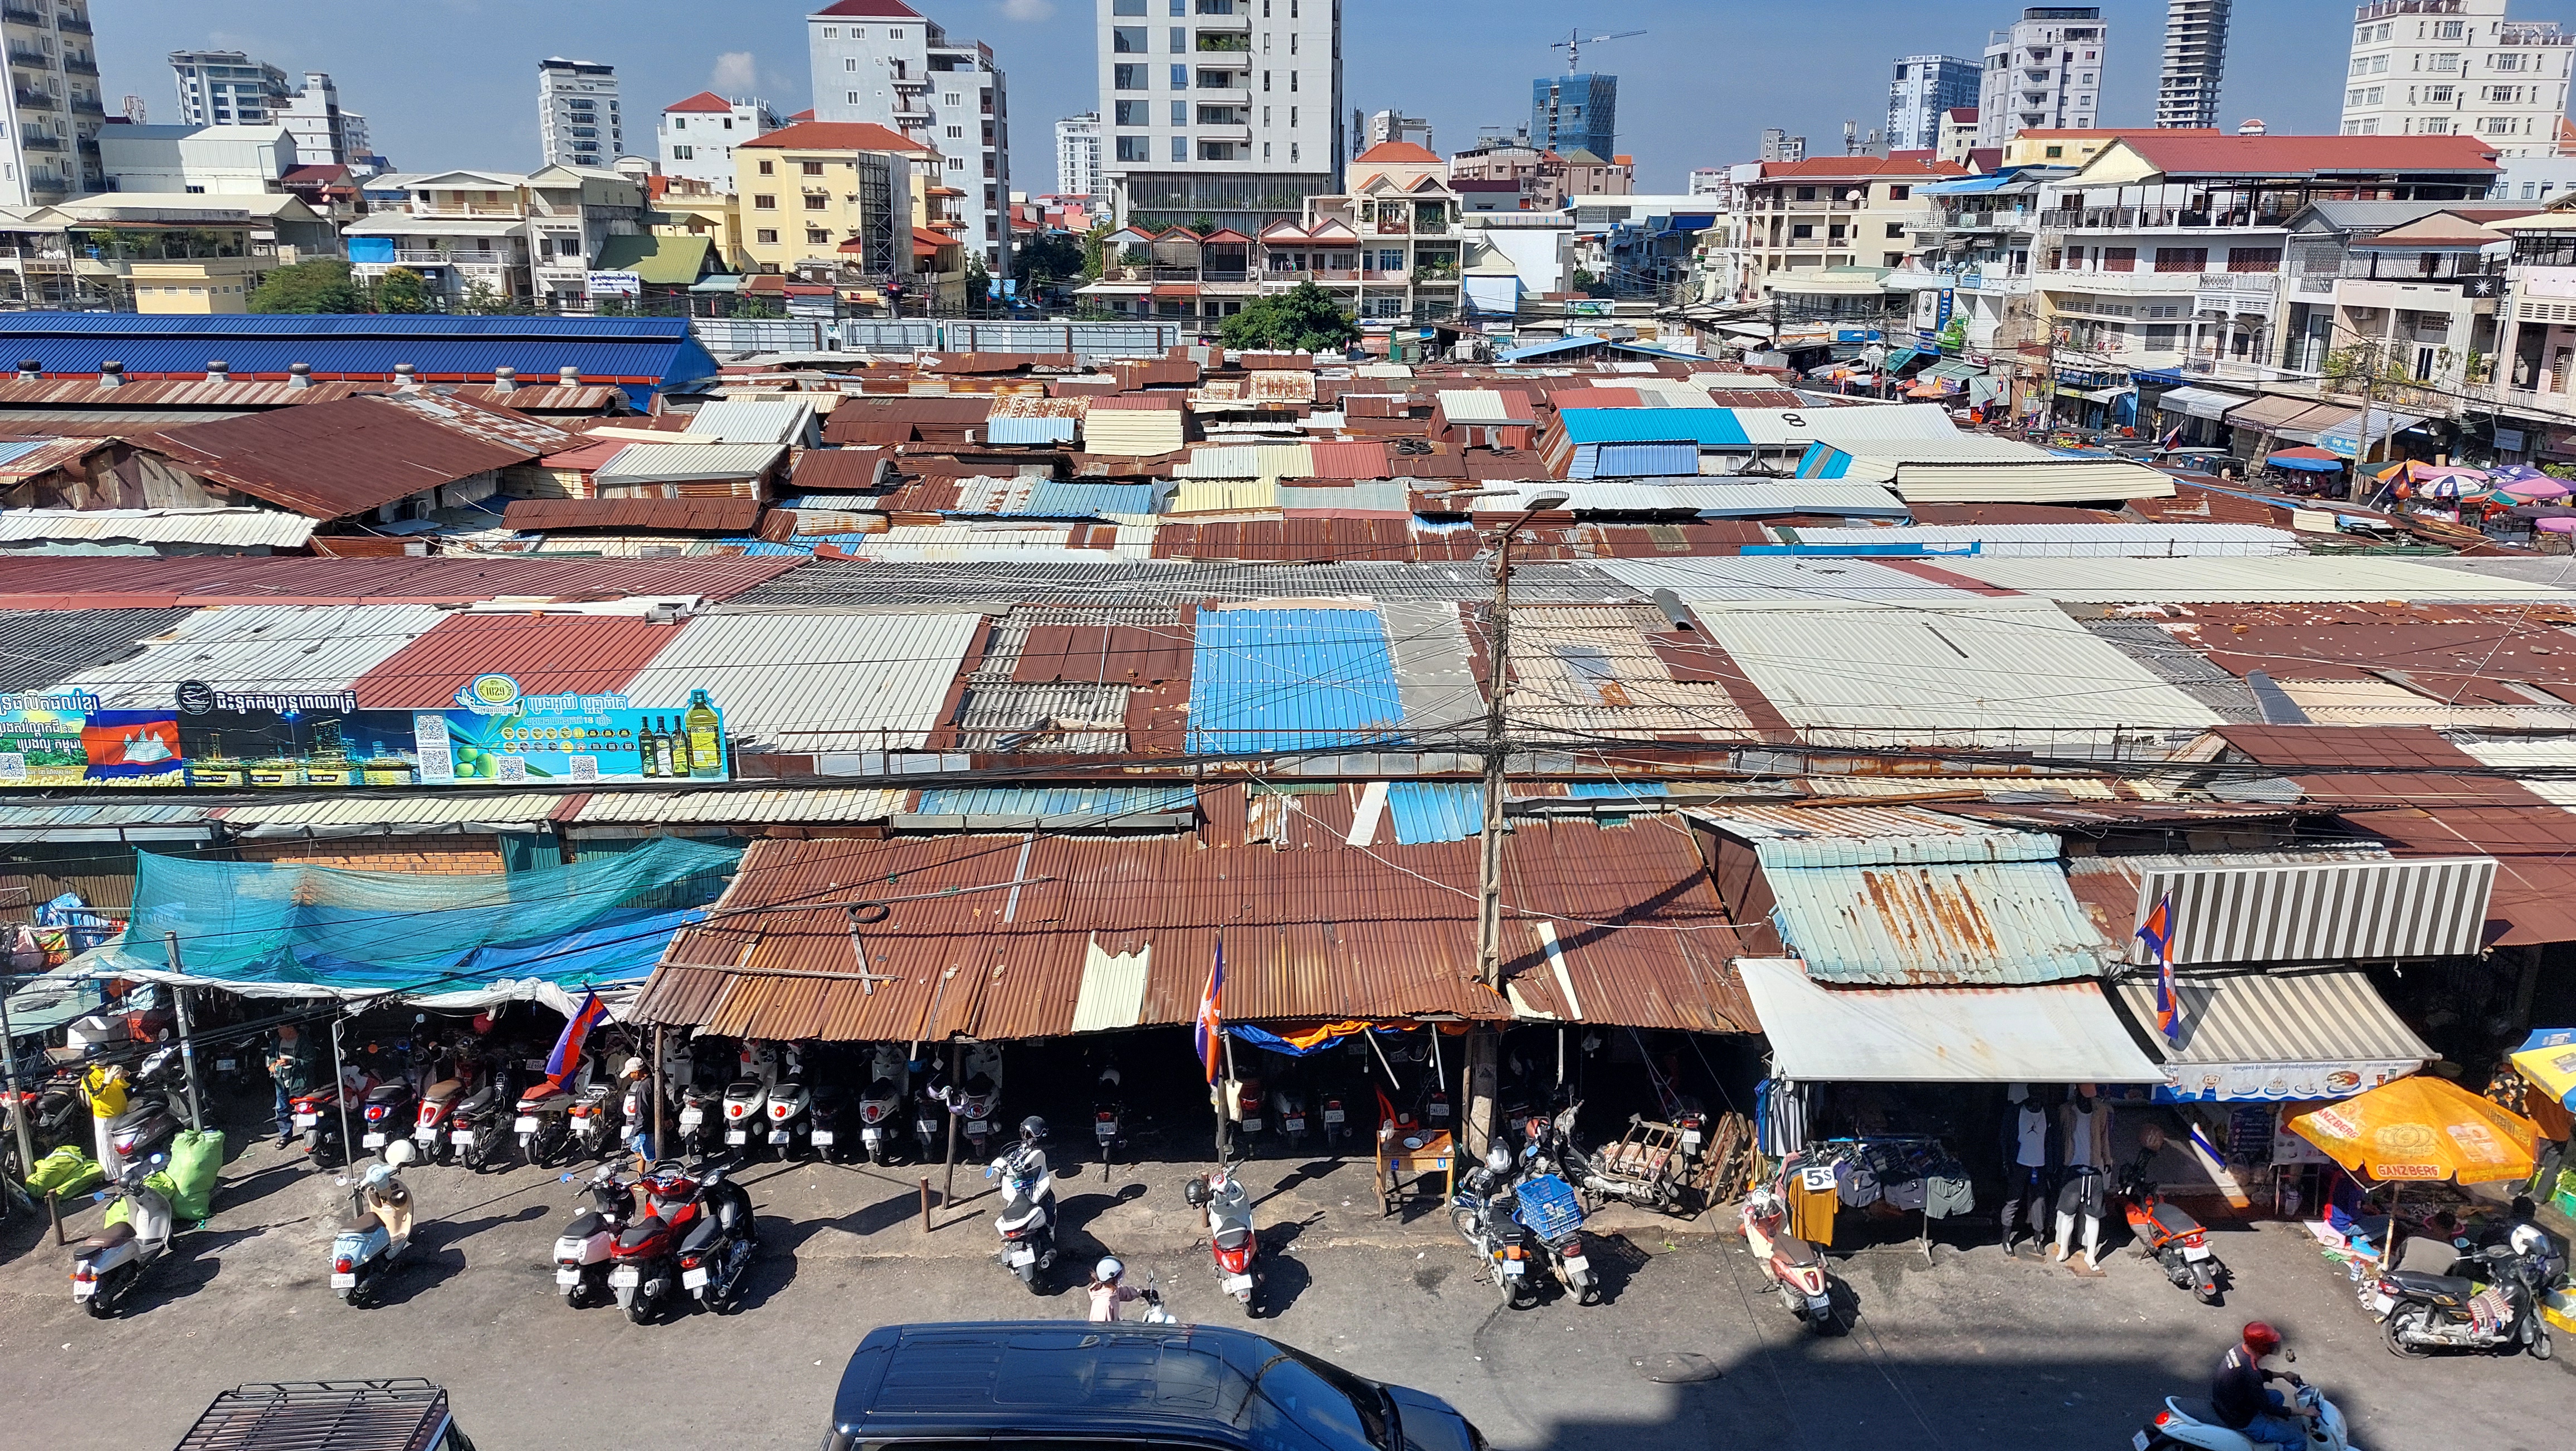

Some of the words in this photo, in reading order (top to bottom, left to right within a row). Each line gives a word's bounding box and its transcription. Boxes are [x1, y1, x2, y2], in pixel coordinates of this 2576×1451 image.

[2315, 1108, 2360, 1139] ANZBERG
[1807, 1170, 1832, 1186] 5$
[2378, 1165, 2439, 1176] GANZBERG
